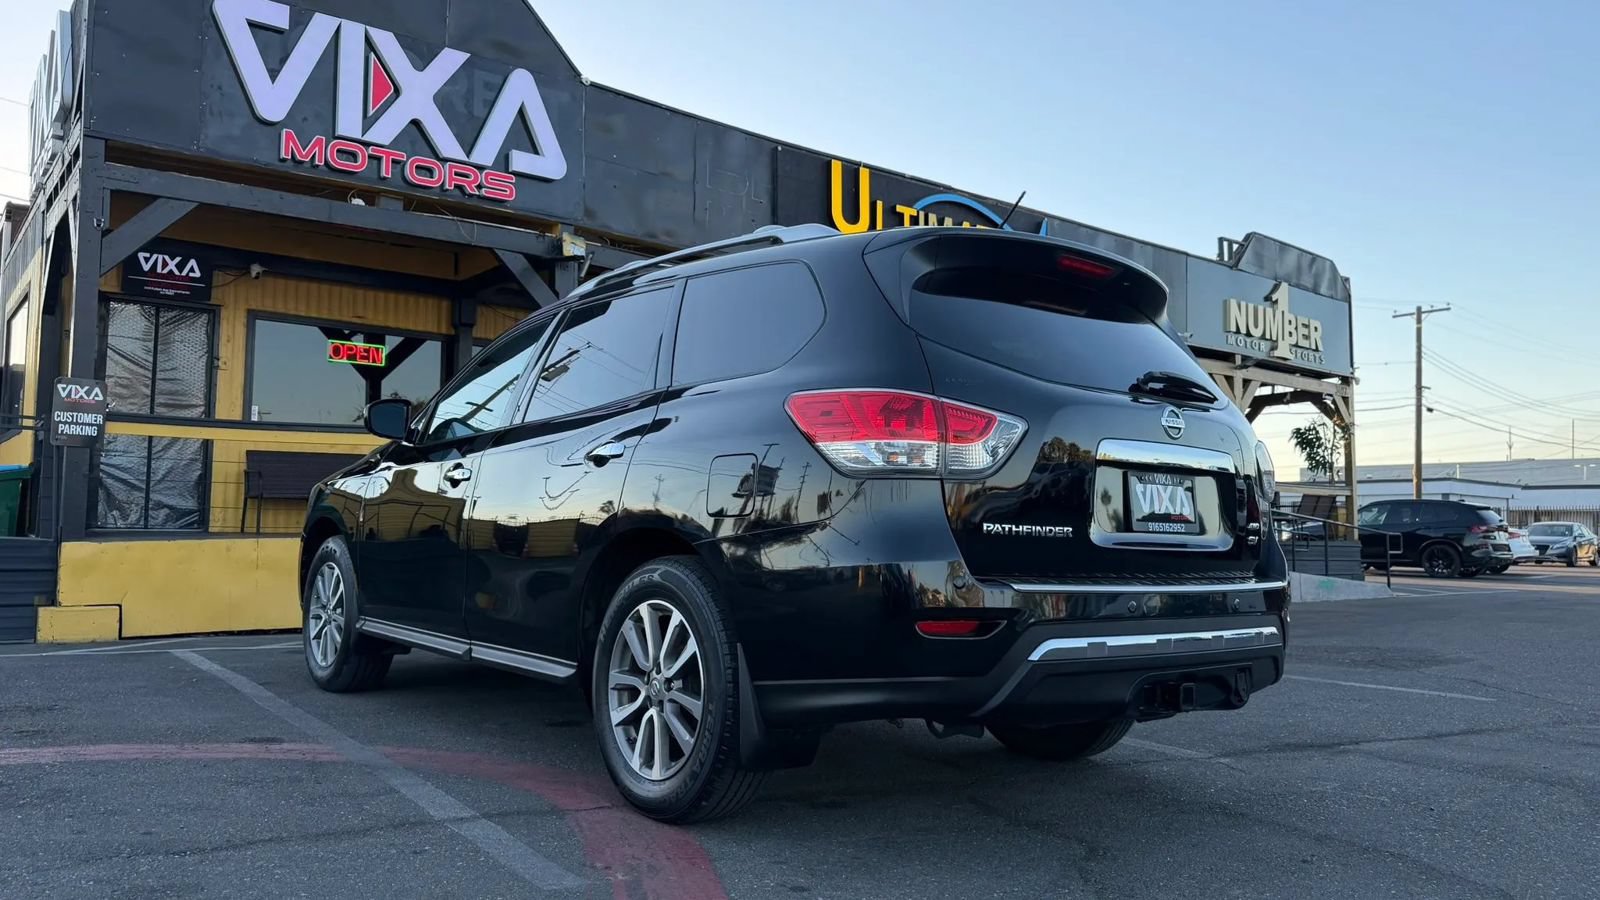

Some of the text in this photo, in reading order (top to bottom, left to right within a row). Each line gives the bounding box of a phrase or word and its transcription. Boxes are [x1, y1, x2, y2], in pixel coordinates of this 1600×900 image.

[212, 0, 567, 181] VIXA
[280, 128, 516, 201] MOTORS
[137, 251, 202, 278] VIXA
[1225, 298, 1323, 351] NUMBER
[1226, 334, 1265, 352] MOTOR
[328, 342, 383, 364] OPEN
[1289, 346, 1325, 364] SPORTS
[57, 384, 104, 400] VIXA
[54, 411, 103, 424] CUSTOMER
[58, 424, 97, 436] PARKING
[1154, 473, 1172, 484] VIXA
[1136, 484, 1190, 514] VIXA
[982, 522, 1073, 538] PATHFINDER
[1148, 522, 1185, 532] 9165162952
